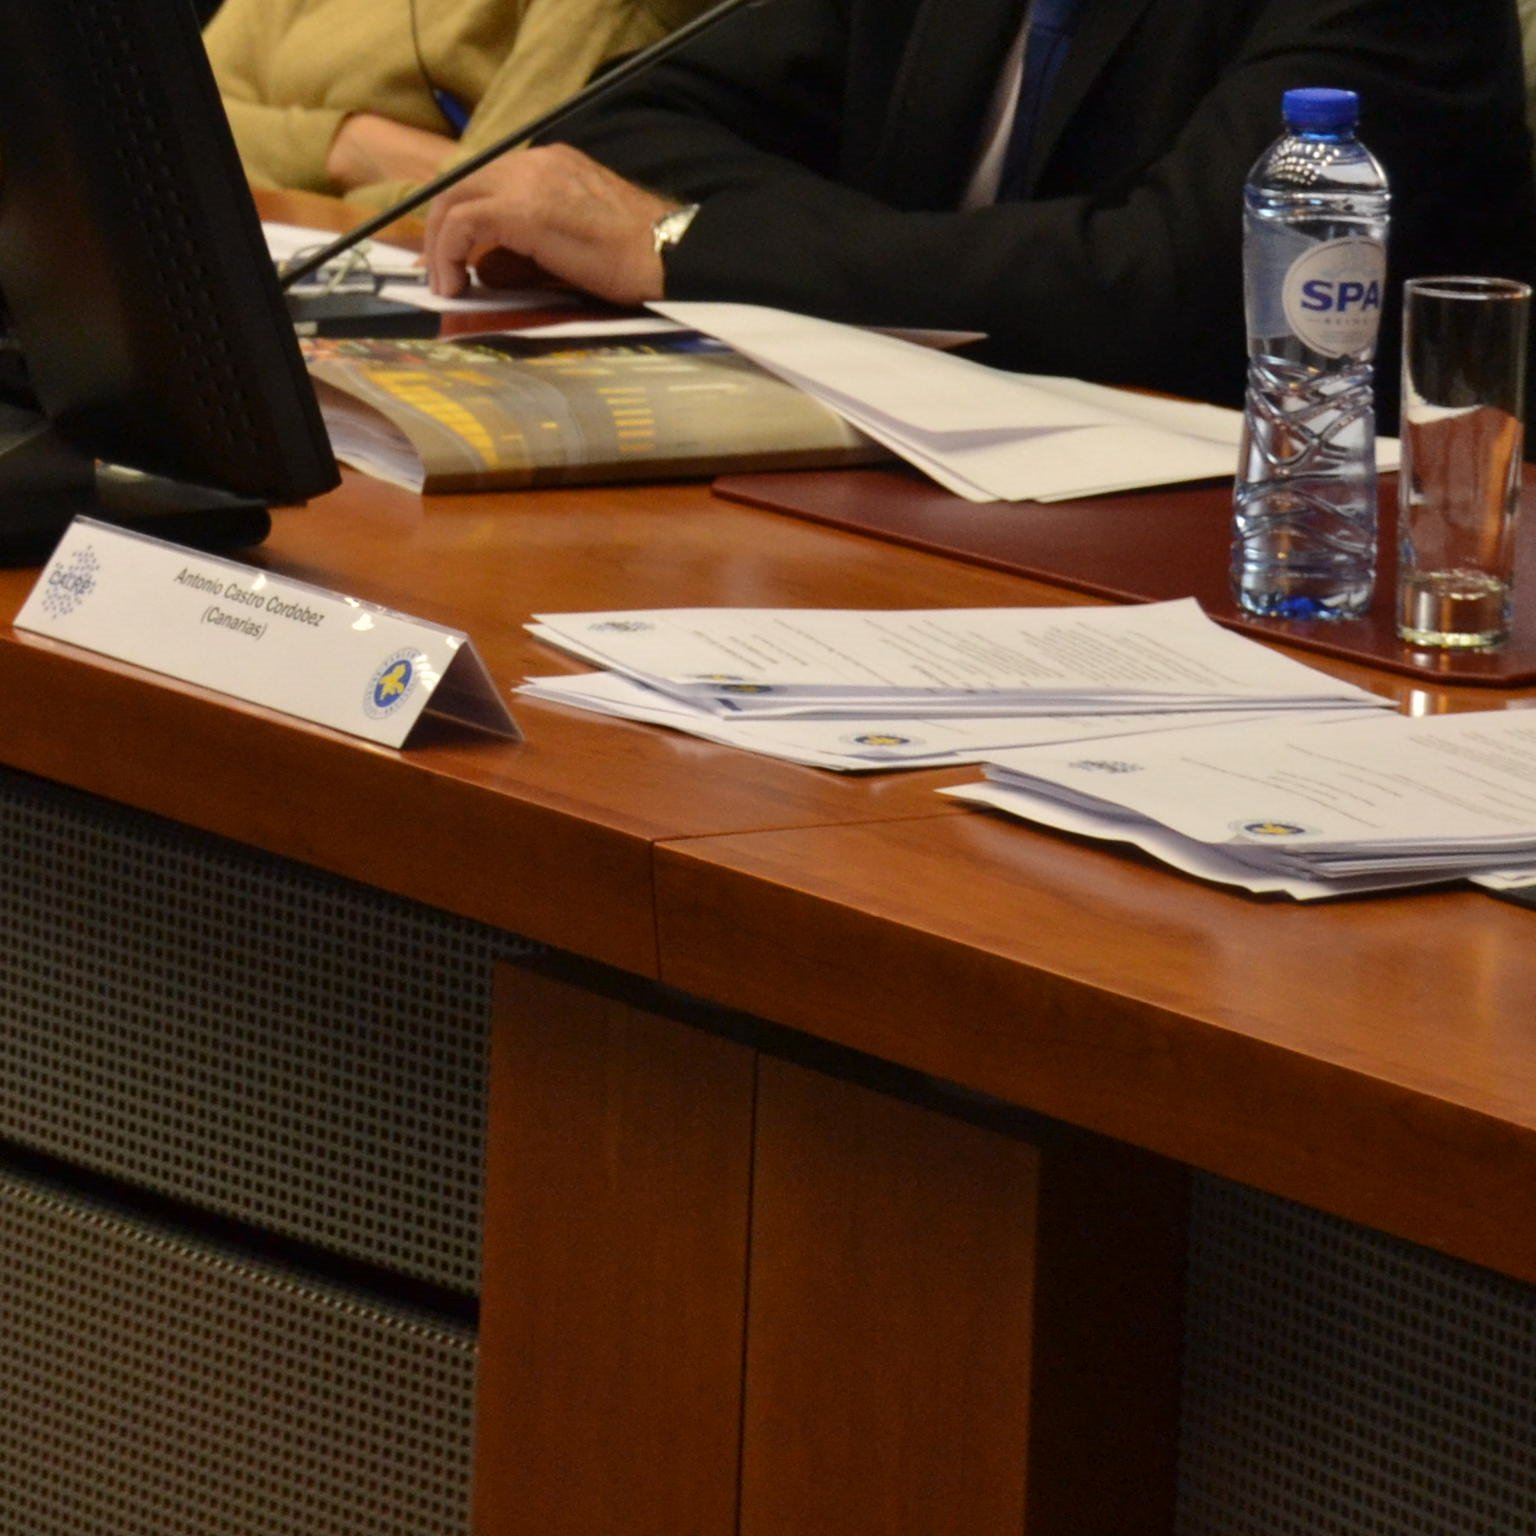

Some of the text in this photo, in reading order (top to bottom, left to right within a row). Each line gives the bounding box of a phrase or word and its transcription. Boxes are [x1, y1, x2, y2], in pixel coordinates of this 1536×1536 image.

[1300, 279, 1379, 312] SPA
[174, 567, 326, 628] Antonio Castro Cordobez
[200, 606, 268, 640] (Canarias)
